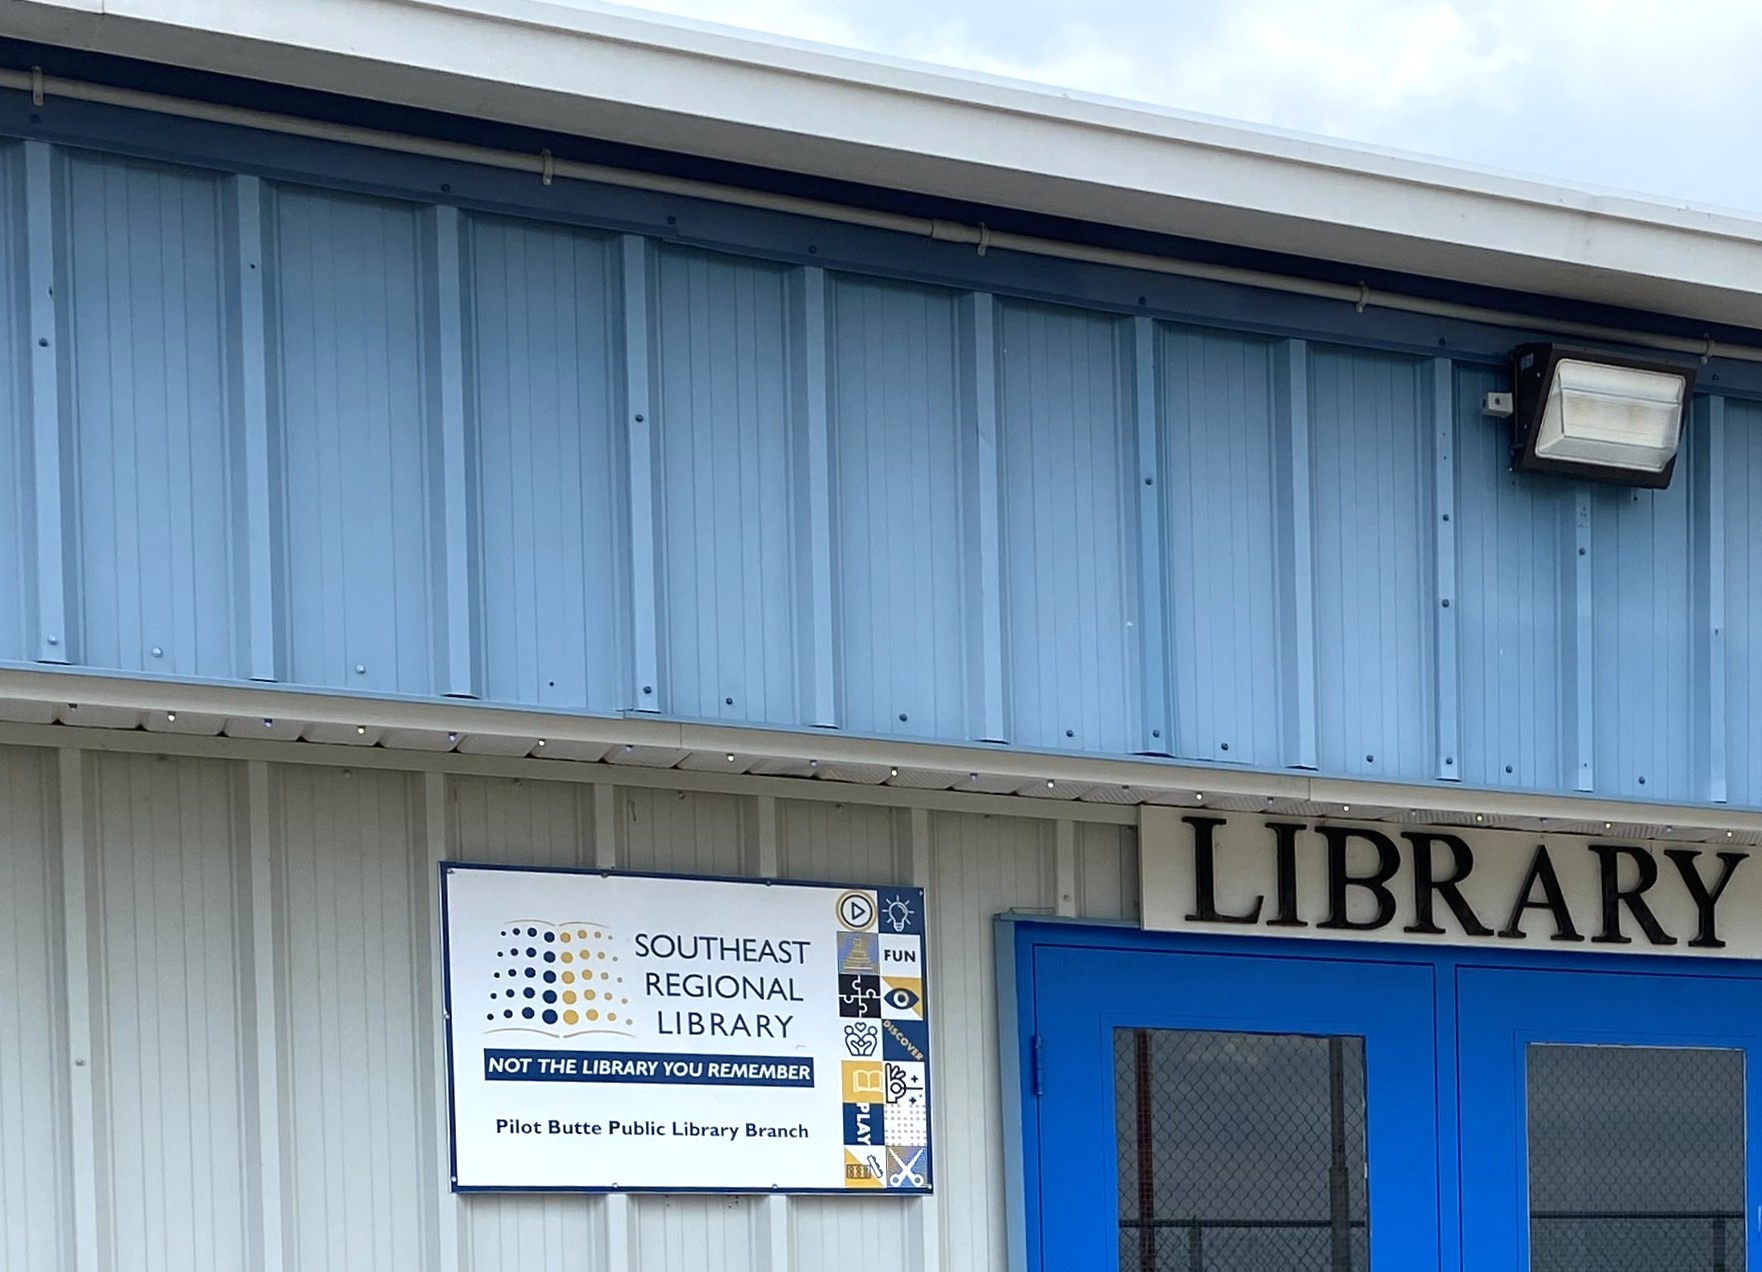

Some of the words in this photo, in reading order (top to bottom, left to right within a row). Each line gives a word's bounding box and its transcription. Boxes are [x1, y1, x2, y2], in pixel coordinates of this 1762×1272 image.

[1180, 816, 1750, 948] LIBRARY
[634, 932, 812, 965] SOUTHEAST
[883, 948, 917, 963] FUN
[645, 971, 805, 1002] REGIONAL
[657, 1010, 794, 1039] LIBRARY
[882, 1019, 925, 1062] DISCOVER
[488, 1057, 533, 1074] NOT
[537, 1058, 578, 1075] THE
[582, 1059, 659, 1076] LIBRARY
[663, 1061, 703, 1077] YOU
[708, 1062, 812, 1080] REMEMBER
[496, 1118, 543, 1135] Pilot
[547, 1119, 603, 1135] Butte
[608, 1120, 667, 1136] Public
[671, 1121, 740, 1142] Library
[745, 1122, 810, 1138] Branch
[855, 1102, 872, 1146] PLAY
